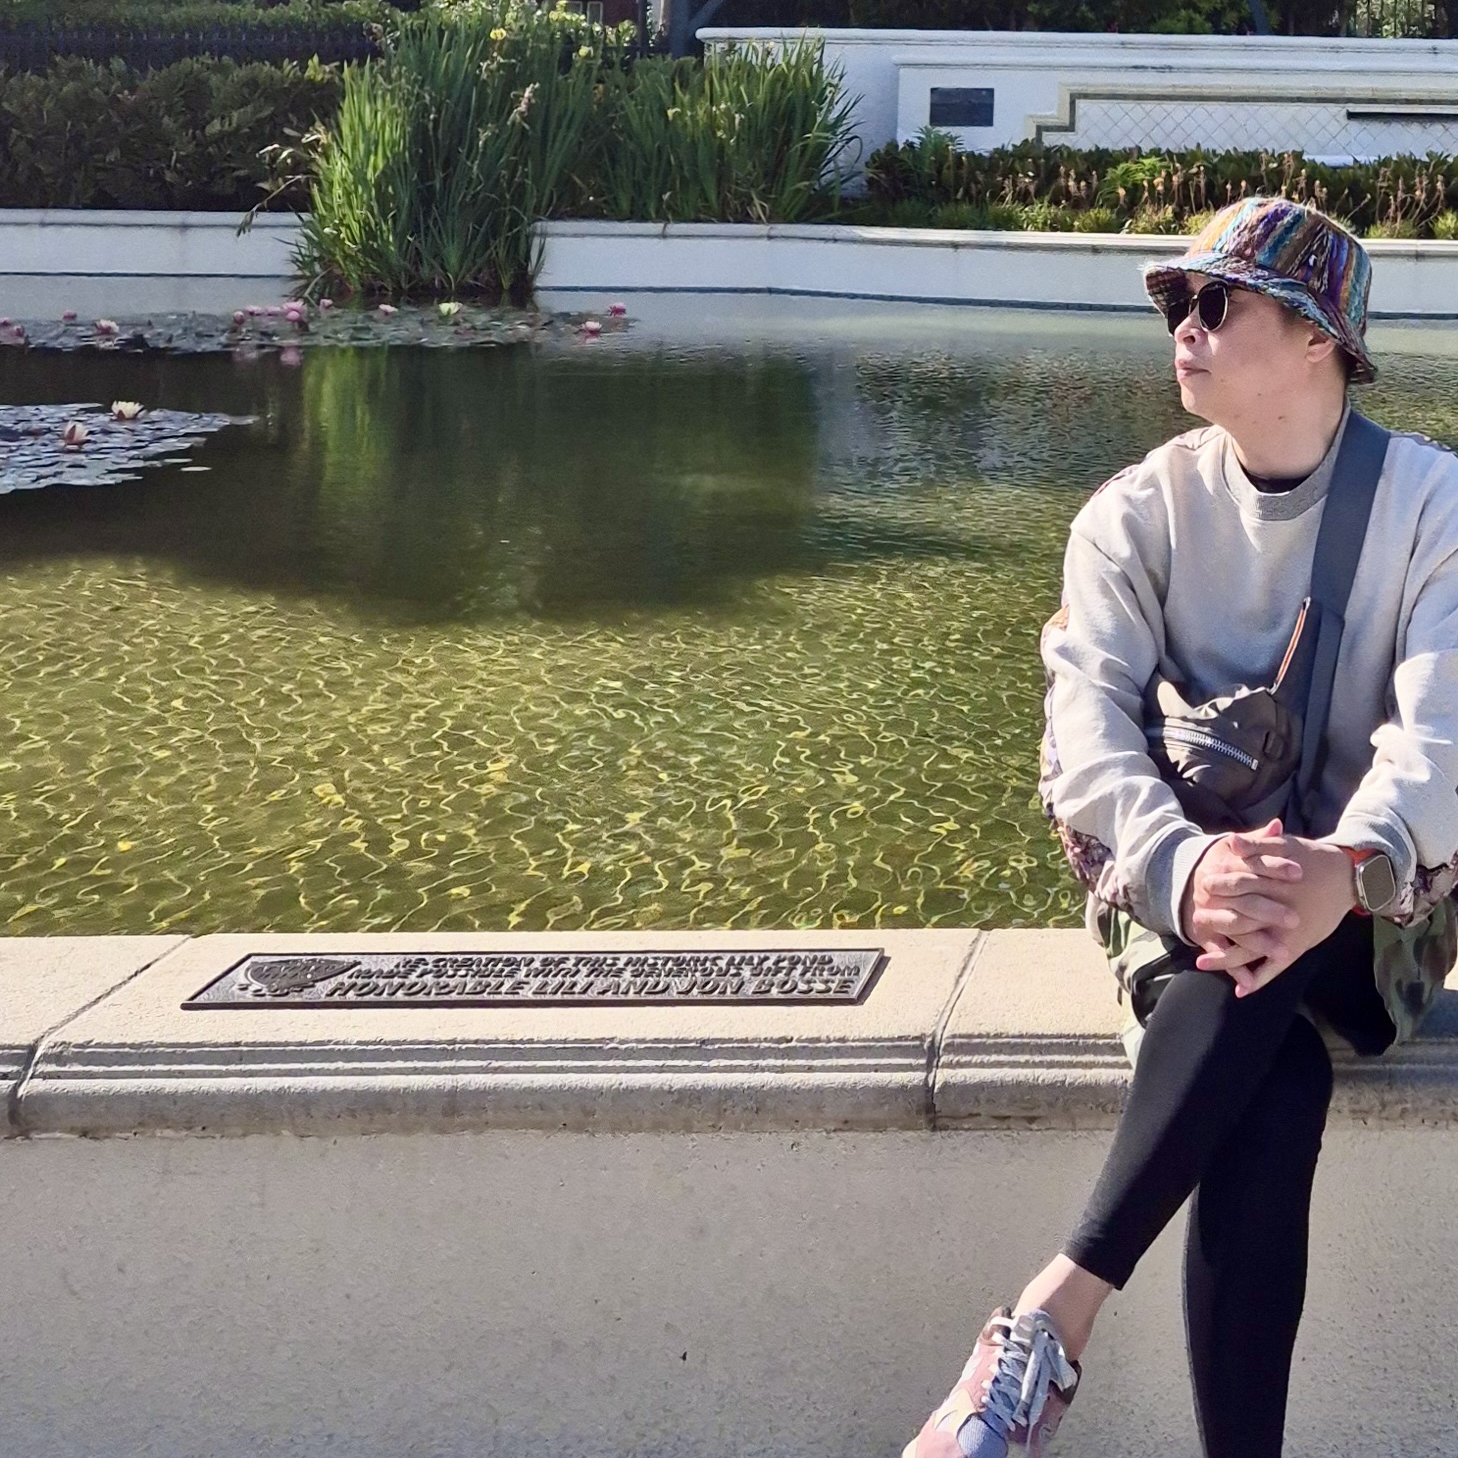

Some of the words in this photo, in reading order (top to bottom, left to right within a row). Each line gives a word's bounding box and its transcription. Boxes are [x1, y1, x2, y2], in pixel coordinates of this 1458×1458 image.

[538, 957, 571, 967] OF
[572, 956, 620, 967] THIS
[623, 956, 724, 967] HISTORIC
[725, 955, 771, 966] LILY
[772, 955, 834, 966] POND
[347, 969, 417, 979] MADE
[416, 968, 521, 979] POSSIBLE
[523, 967, 581, 978] WITH
[583, 967, 627, 978] THE
[629, 966, 747, 978] GENEROUS
[749, 966, 798, 977] GIFT
[799, 966, 861, 977] FROM
[324, 980, 530, 997] HONORABLE
[531, 980, 597, 995] LILI
[596, 979, 672, 995] AND
[673, 979, 745, 995] JON
[751, 978, 856, 994] BOSSE
